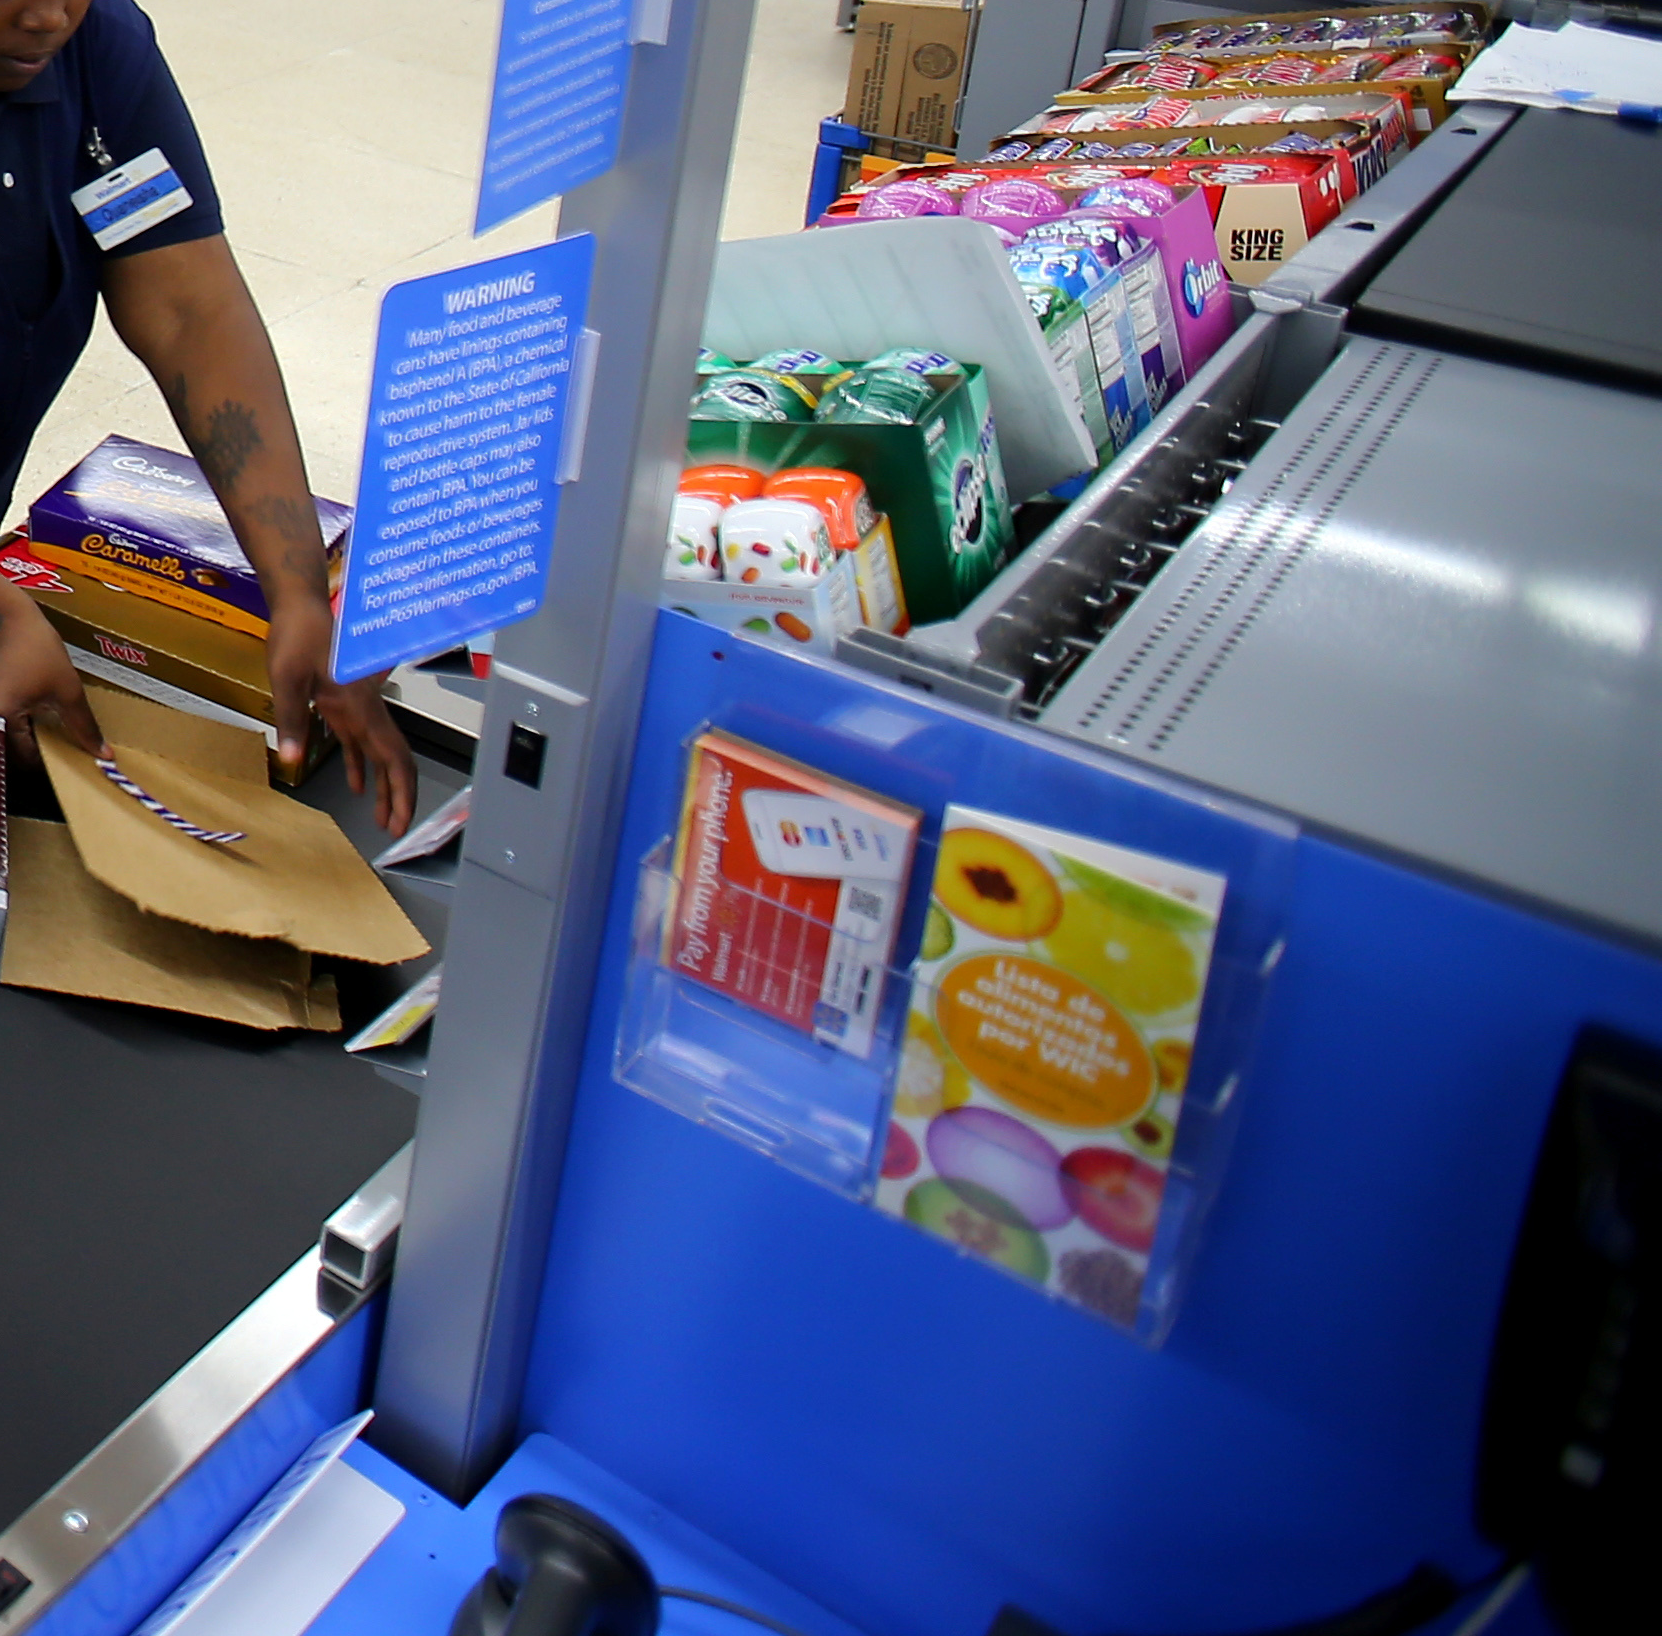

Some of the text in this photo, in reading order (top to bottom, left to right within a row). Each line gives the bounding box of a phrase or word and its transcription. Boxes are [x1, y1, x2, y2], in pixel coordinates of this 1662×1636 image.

[1230, 245, 1283, 262] SIZE
[1231, 228, 1284, 248] KING
[444, 270, 537, 315] WARNING
[407, 291, 563, 352] Many food and beverage
[395, 314, 568, 377] cans have linings containing
[388, 335, 568, 405] bisphenol A (BPA), a chemical
[112, 456, 196, 488] Cadbury
[80, 533, 185, 582] Caramello
[94, 634, 148, 666] Twix
